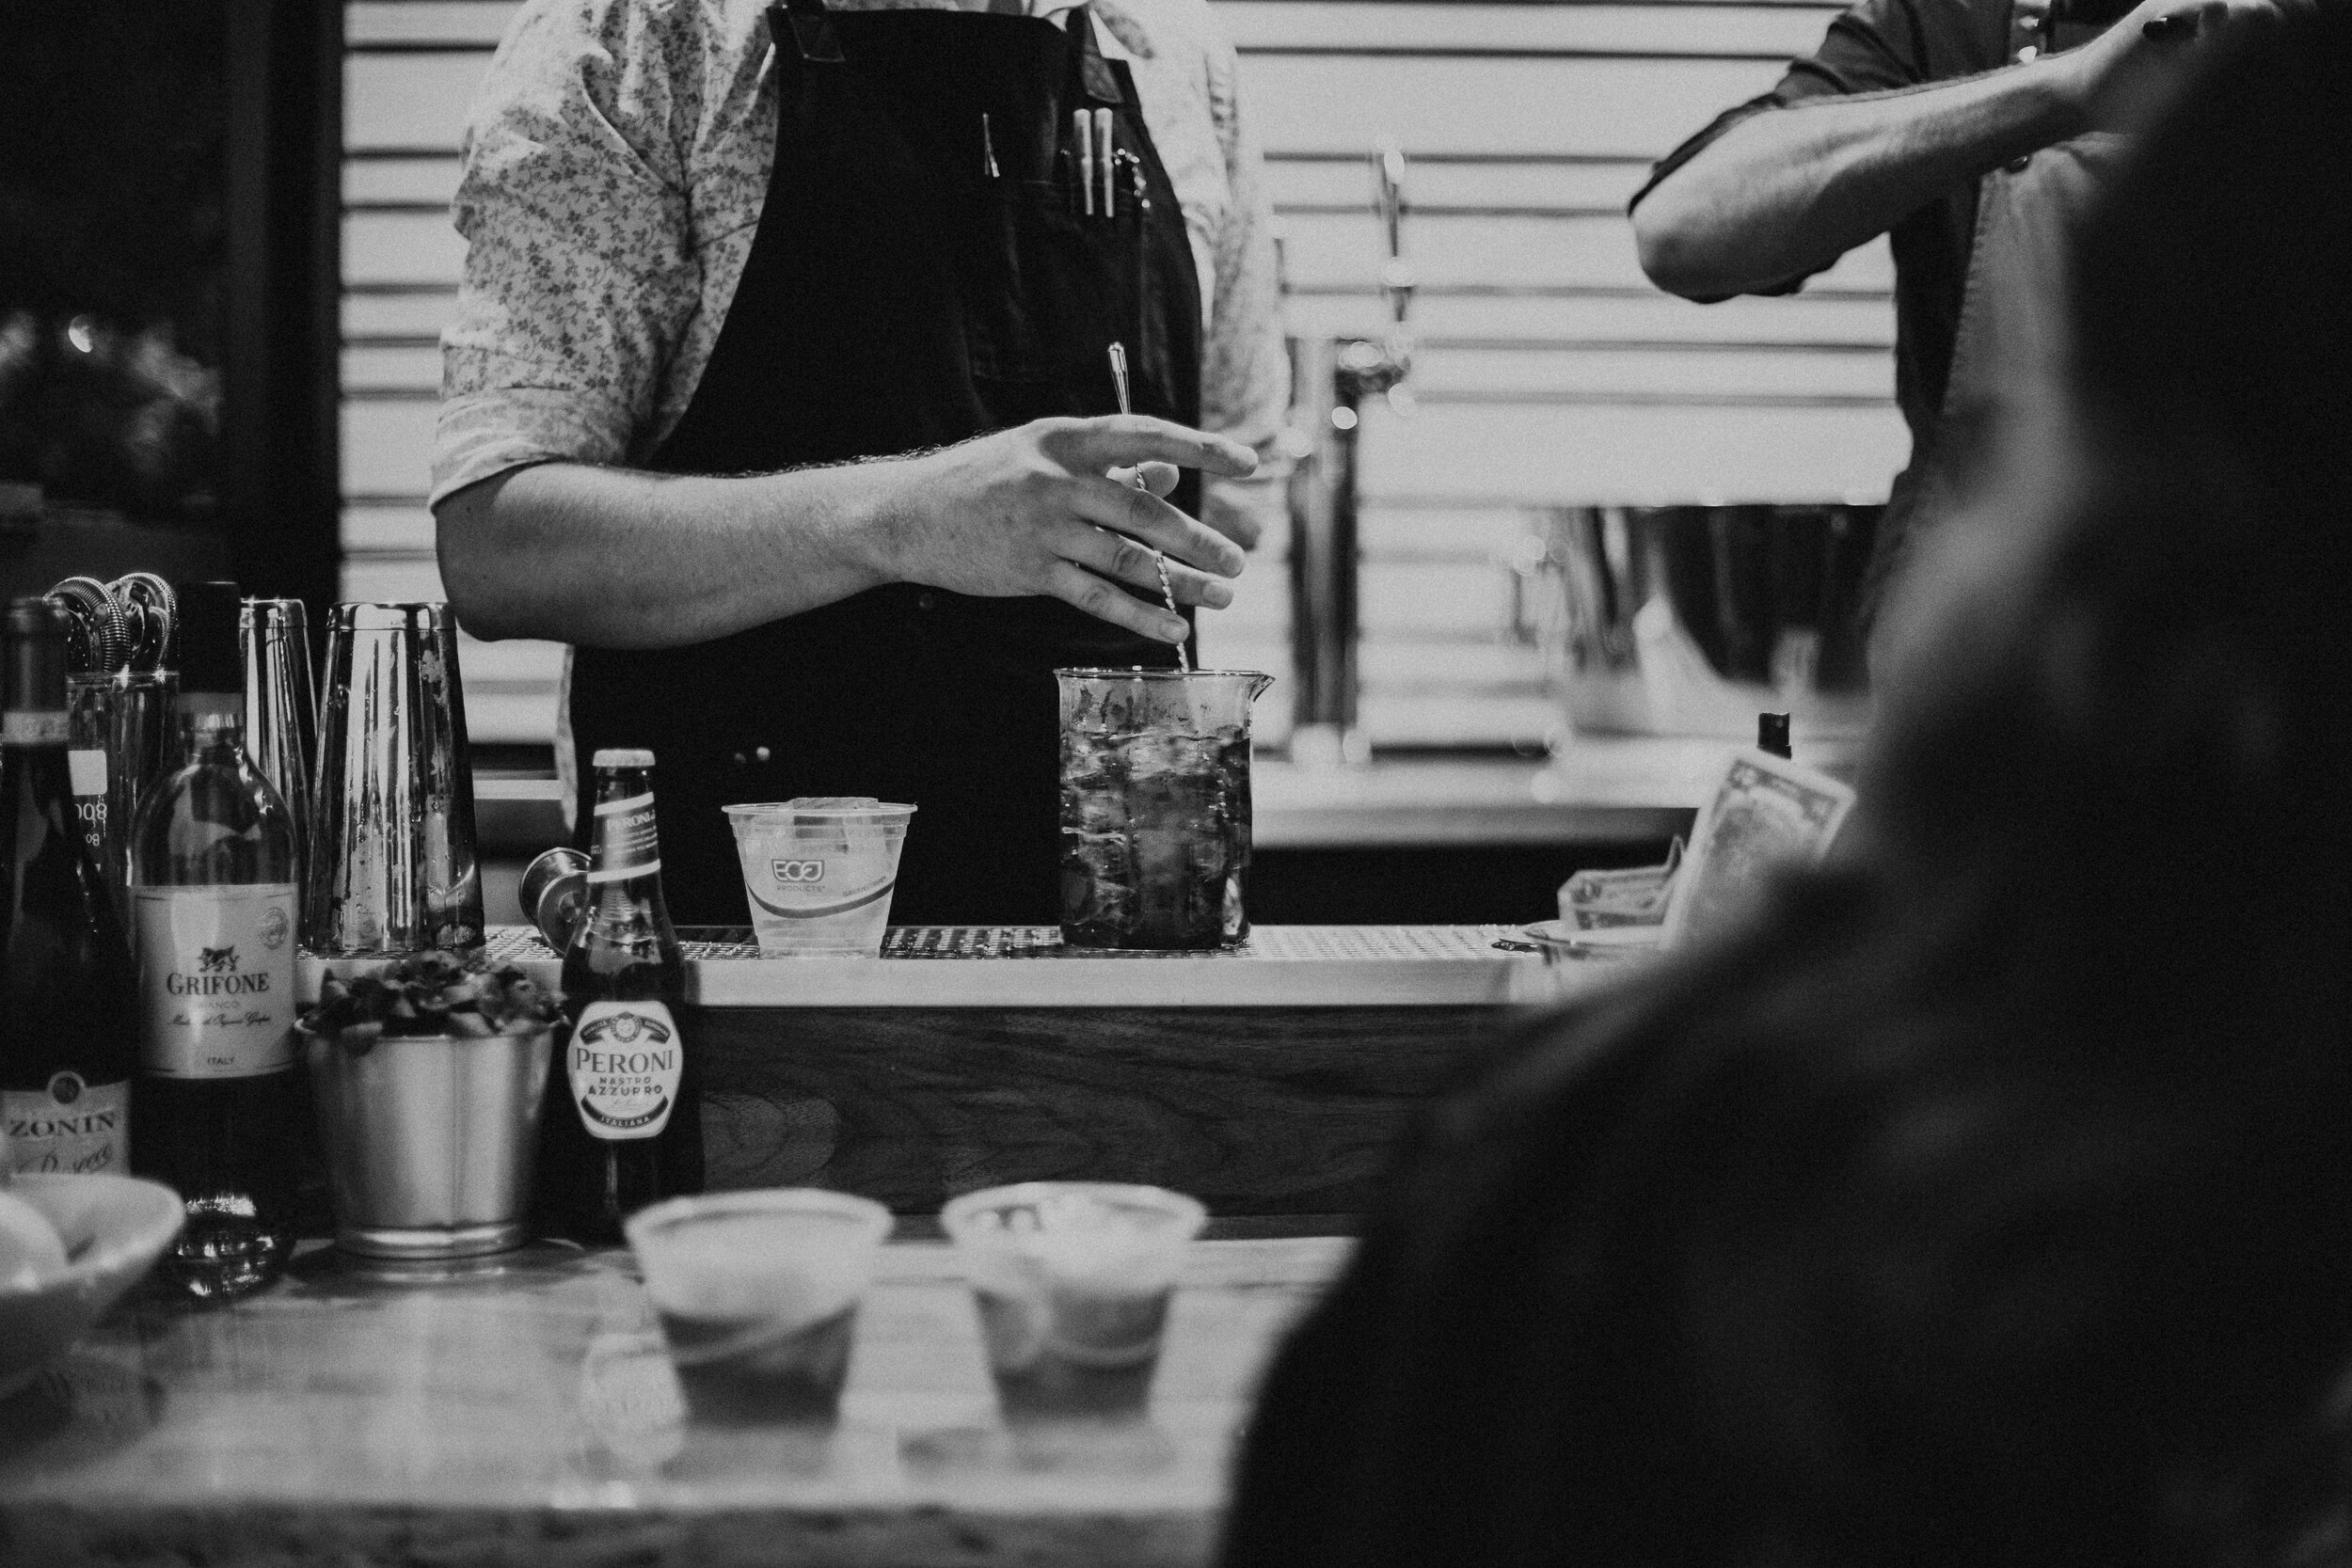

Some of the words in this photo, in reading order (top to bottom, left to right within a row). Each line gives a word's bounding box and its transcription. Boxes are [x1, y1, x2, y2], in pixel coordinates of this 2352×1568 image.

[167, 972, 270, 996] GRIFONE
[207, 1056, 234, 1067] ITALY
[576, 1047, 674, 1074] PERONI
[599, 1076, 652, 1085] NASTRO
[588, 1085, 663, 1097] AZZURRO
[8, 1111, 115, 1138] ZONIN
[600, 1116, 650, 1128] ITALIANA
